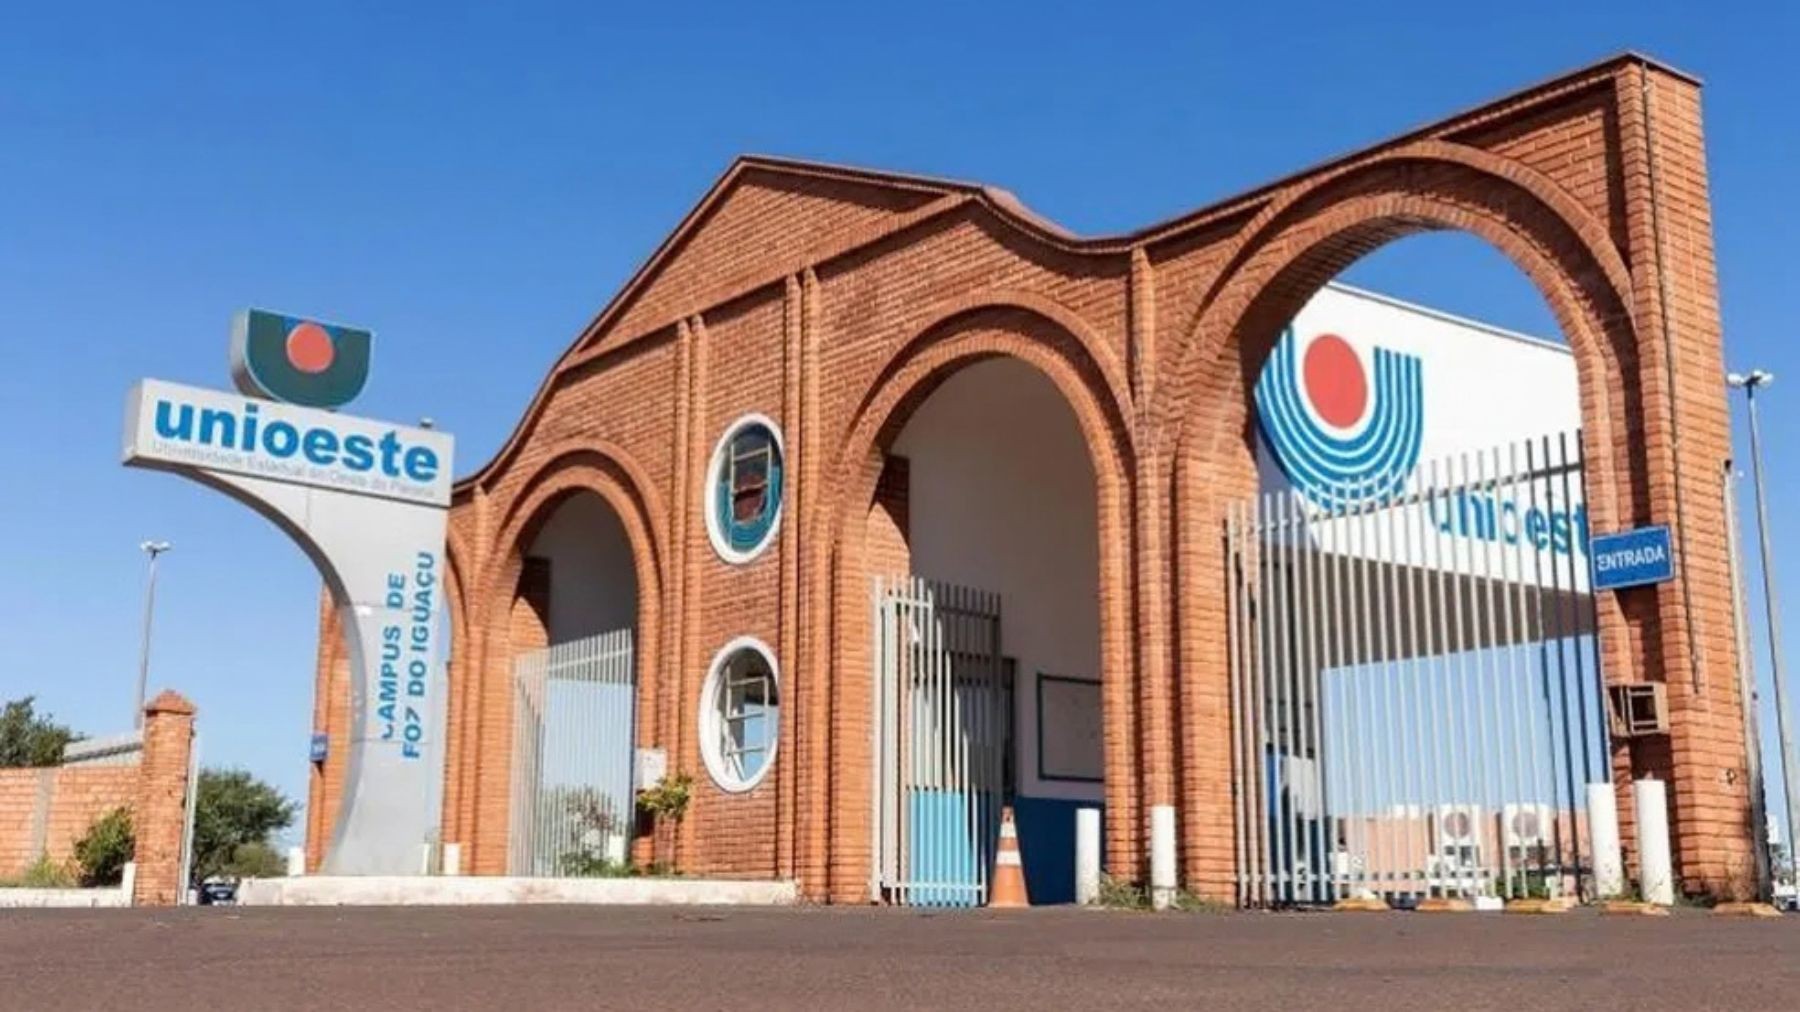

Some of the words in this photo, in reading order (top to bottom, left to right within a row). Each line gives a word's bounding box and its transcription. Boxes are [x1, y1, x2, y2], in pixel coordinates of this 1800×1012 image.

[154, 400, 439, 482] unioeste
[1429, 484, 1589, 557] unioest
[1597, 545, 1665, 572] ENTRADA
[387, 573, 405, 608] DE
[408, 660, 426, 696] DO
